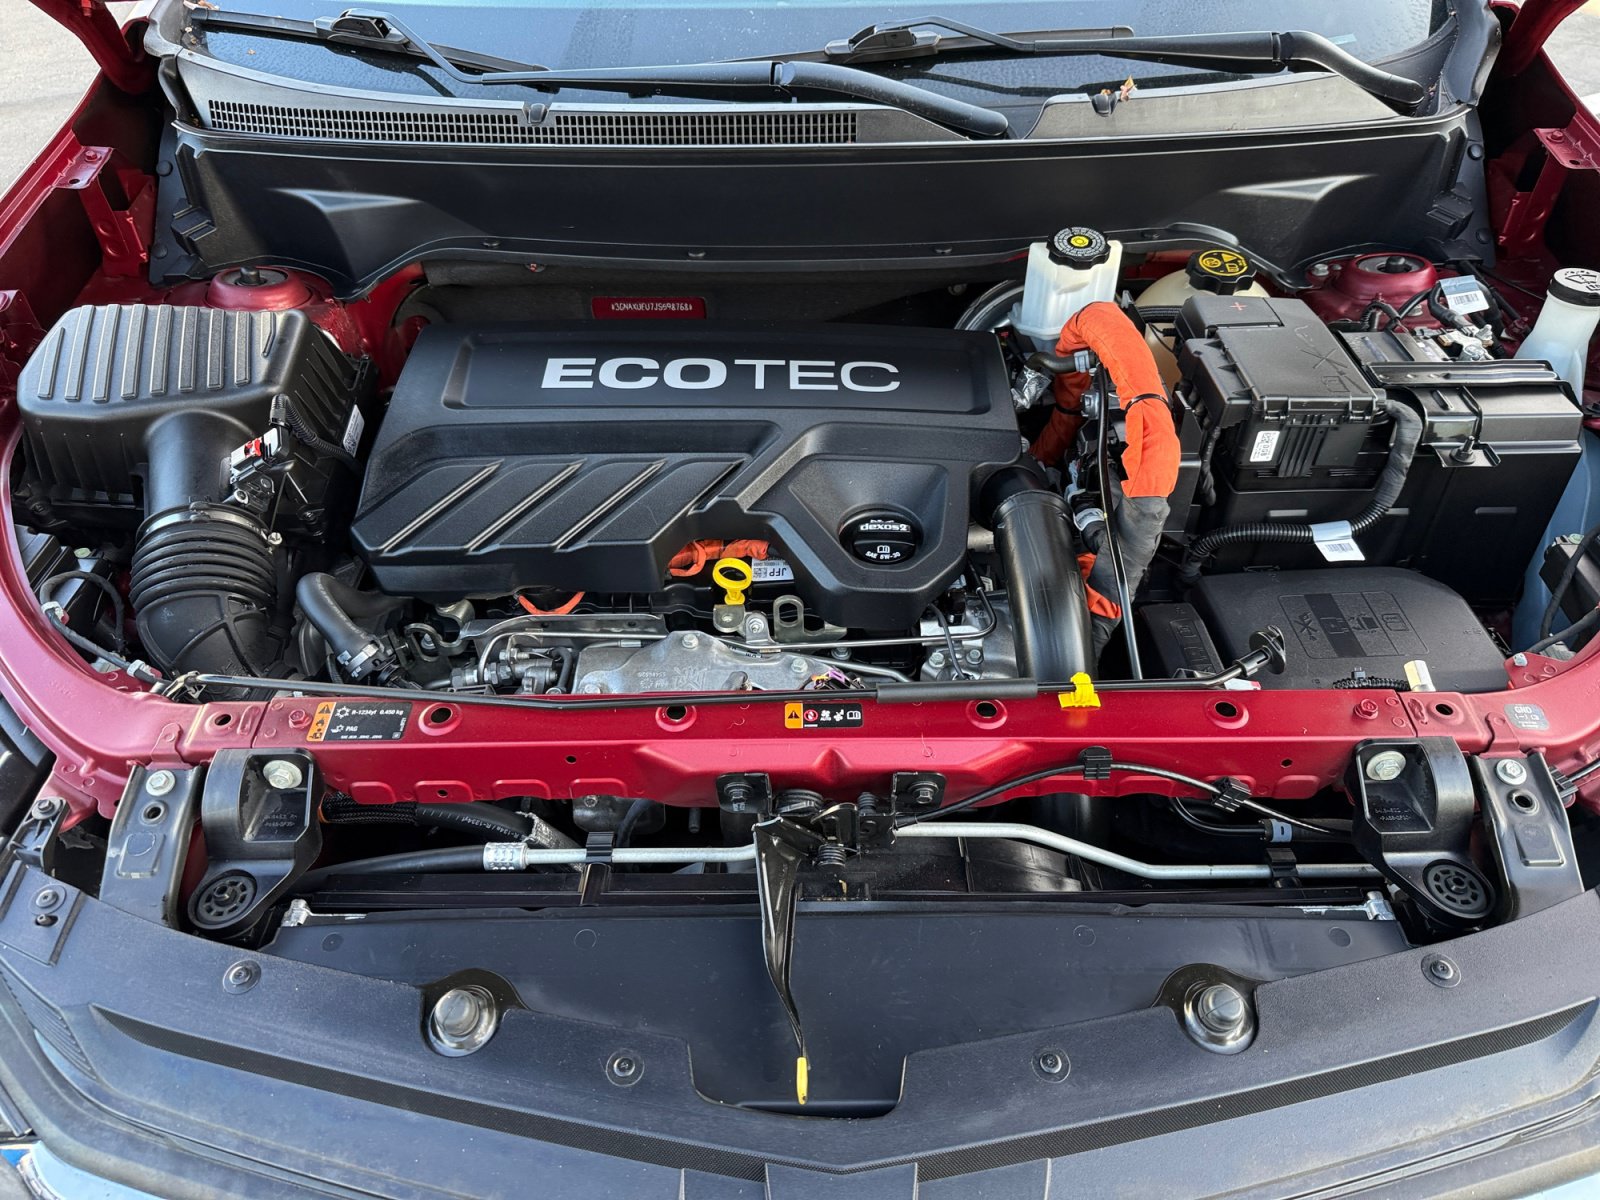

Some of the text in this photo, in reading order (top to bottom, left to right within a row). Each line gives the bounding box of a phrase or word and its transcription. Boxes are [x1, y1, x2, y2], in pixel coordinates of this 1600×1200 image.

[541, 357, 901, 393] ECOTEC
[769, 567, 787, 577] JFP
[1514, 706, 1532, 714] GND
